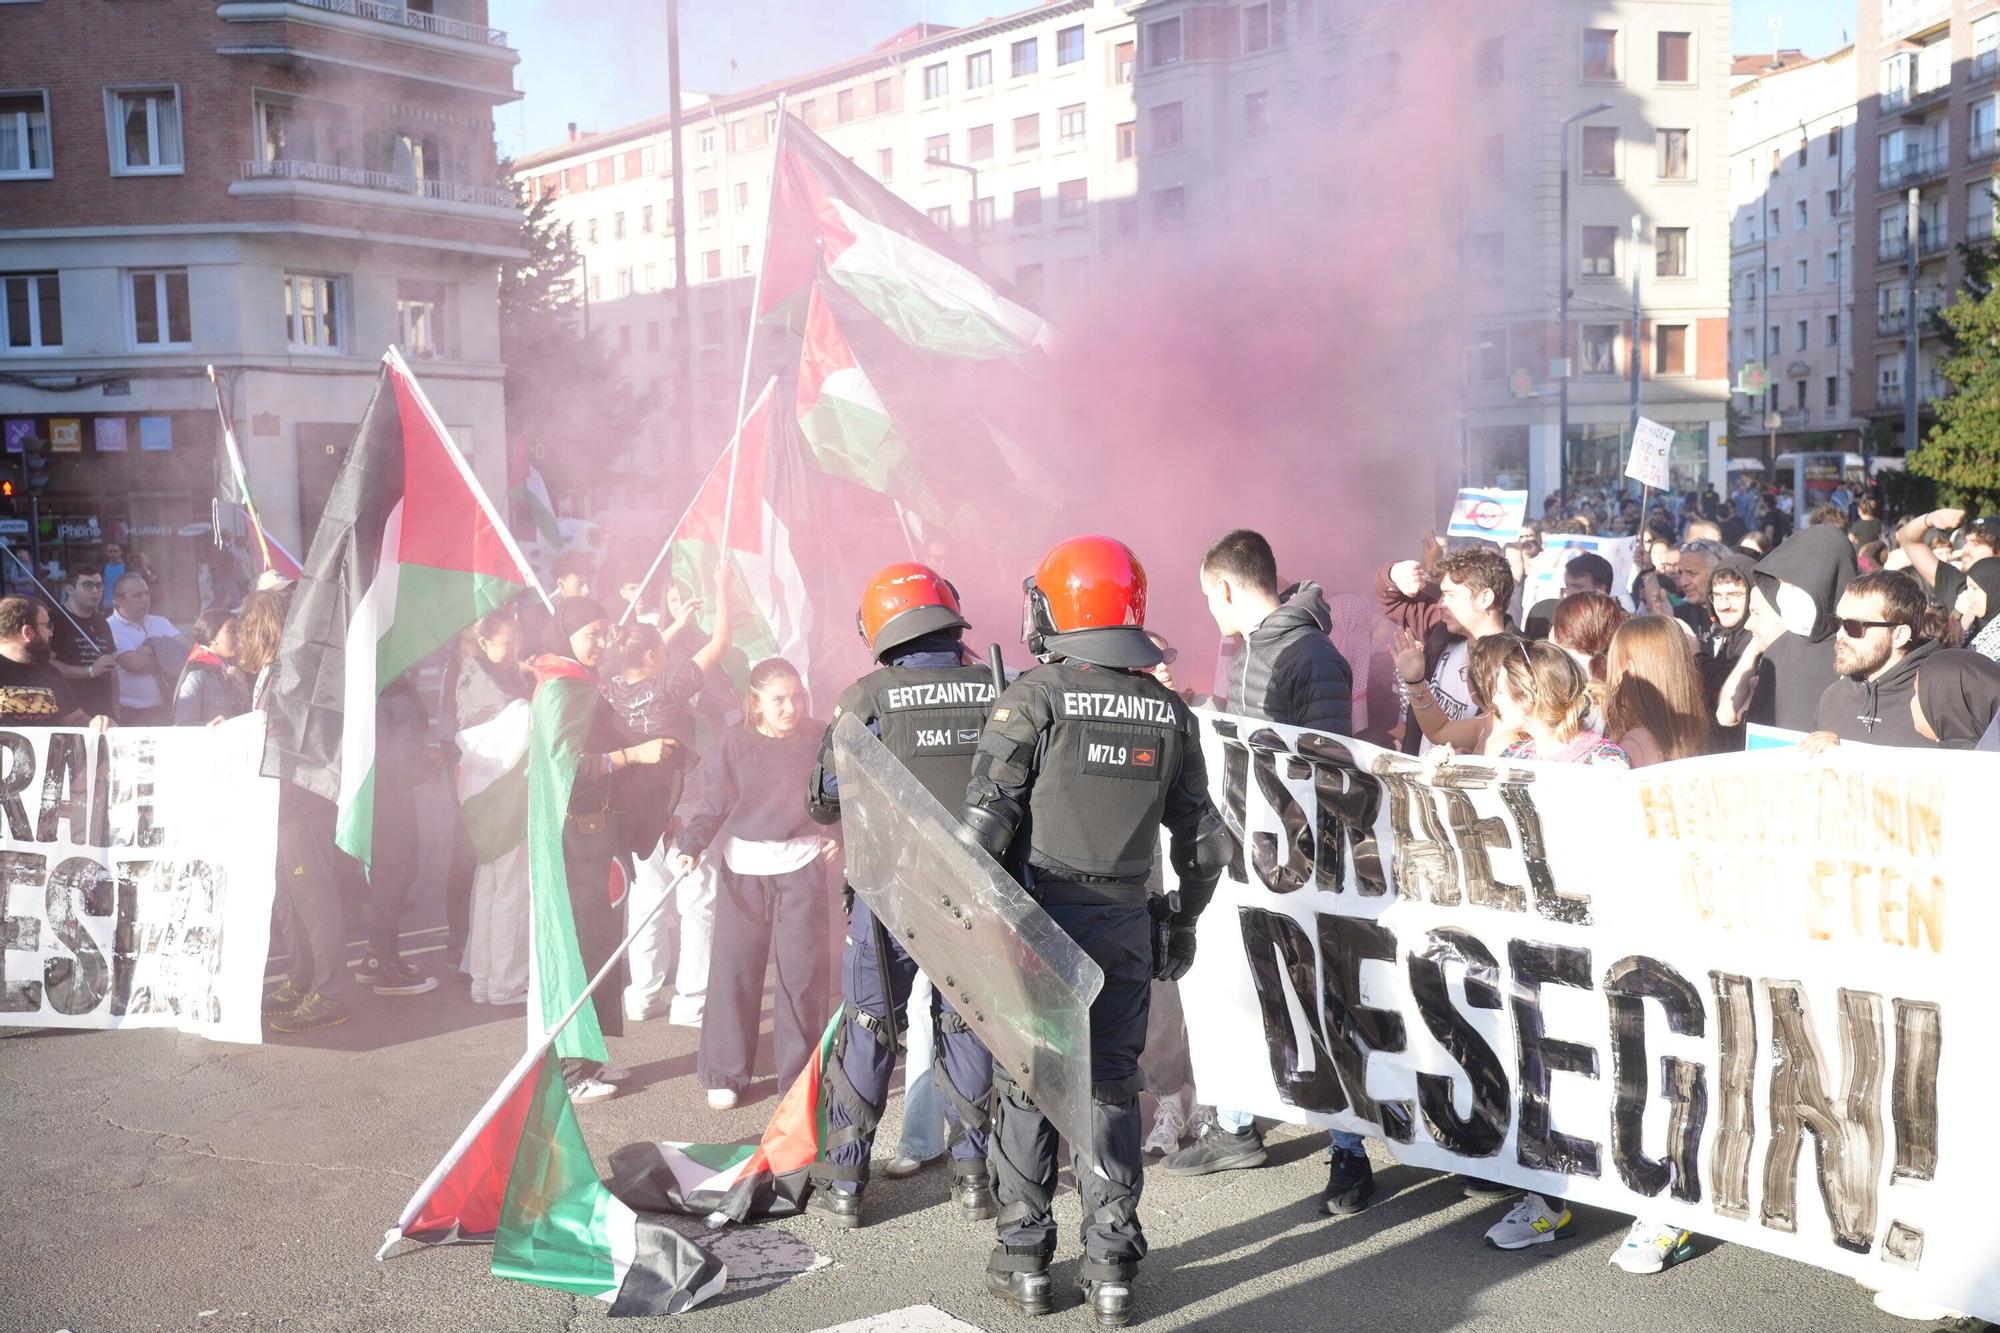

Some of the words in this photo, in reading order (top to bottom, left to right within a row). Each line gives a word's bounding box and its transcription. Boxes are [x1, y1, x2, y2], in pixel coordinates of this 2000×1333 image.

[58, 524, 101, 537] iPhone
[127, 527, 172, 537] HUAWEI
[888, 682, 996, 709] ERTZAINTZA
[1063, 692, 1177, 725] ERTZAINTZA
[916, 729, 952, 747] X5A1
[1087, 743, 1127, 766] M7L9
[1211, 719, 1593, 926] ISRAEL
[1238, 904, 1942, 1272] DESEGIN!
